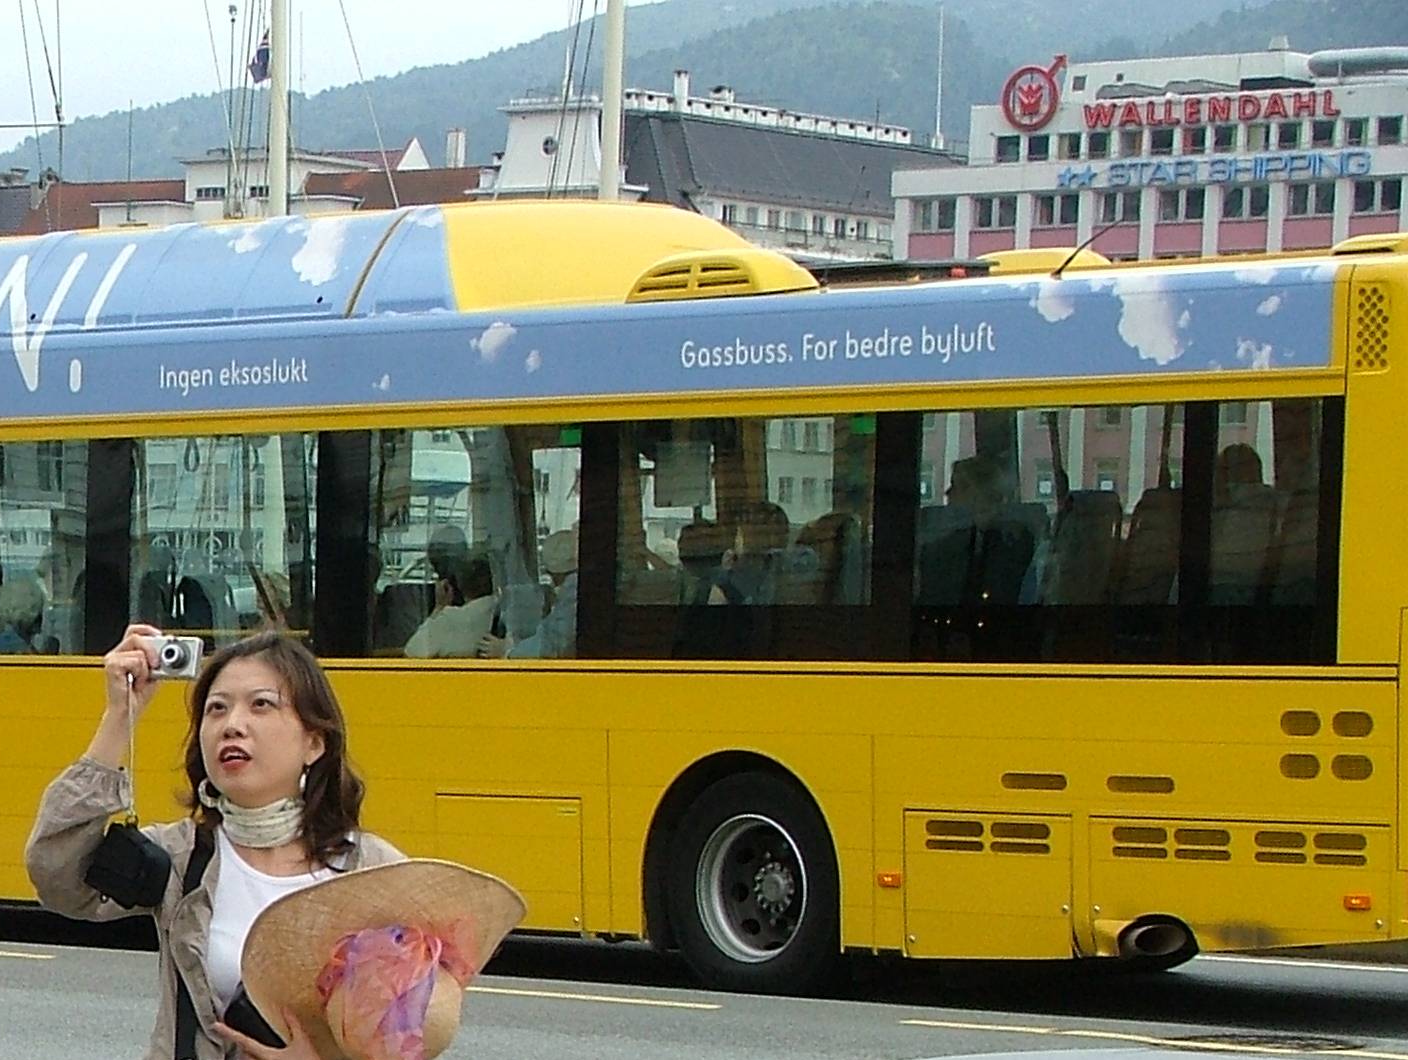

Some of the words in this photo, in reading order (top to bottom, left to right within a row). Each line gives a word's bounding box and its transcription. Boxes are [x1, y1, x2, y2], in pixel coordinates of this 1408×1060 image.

[1083, 89, 1341, 128] WALLENDAHL
[1108, 160, 1198, 187] STAR
[1208, 151, 1371, 183] SHIPPING
[680, 337, 794, 368] Gassbuss.
[802, 333, 838, 361] For
[845, 328, 913, 360] bedre
[922, 321, 996, 364] byluft
[160, 364, 213, 397] Ingen
[219, 357, 309, 386] eksoslukt
